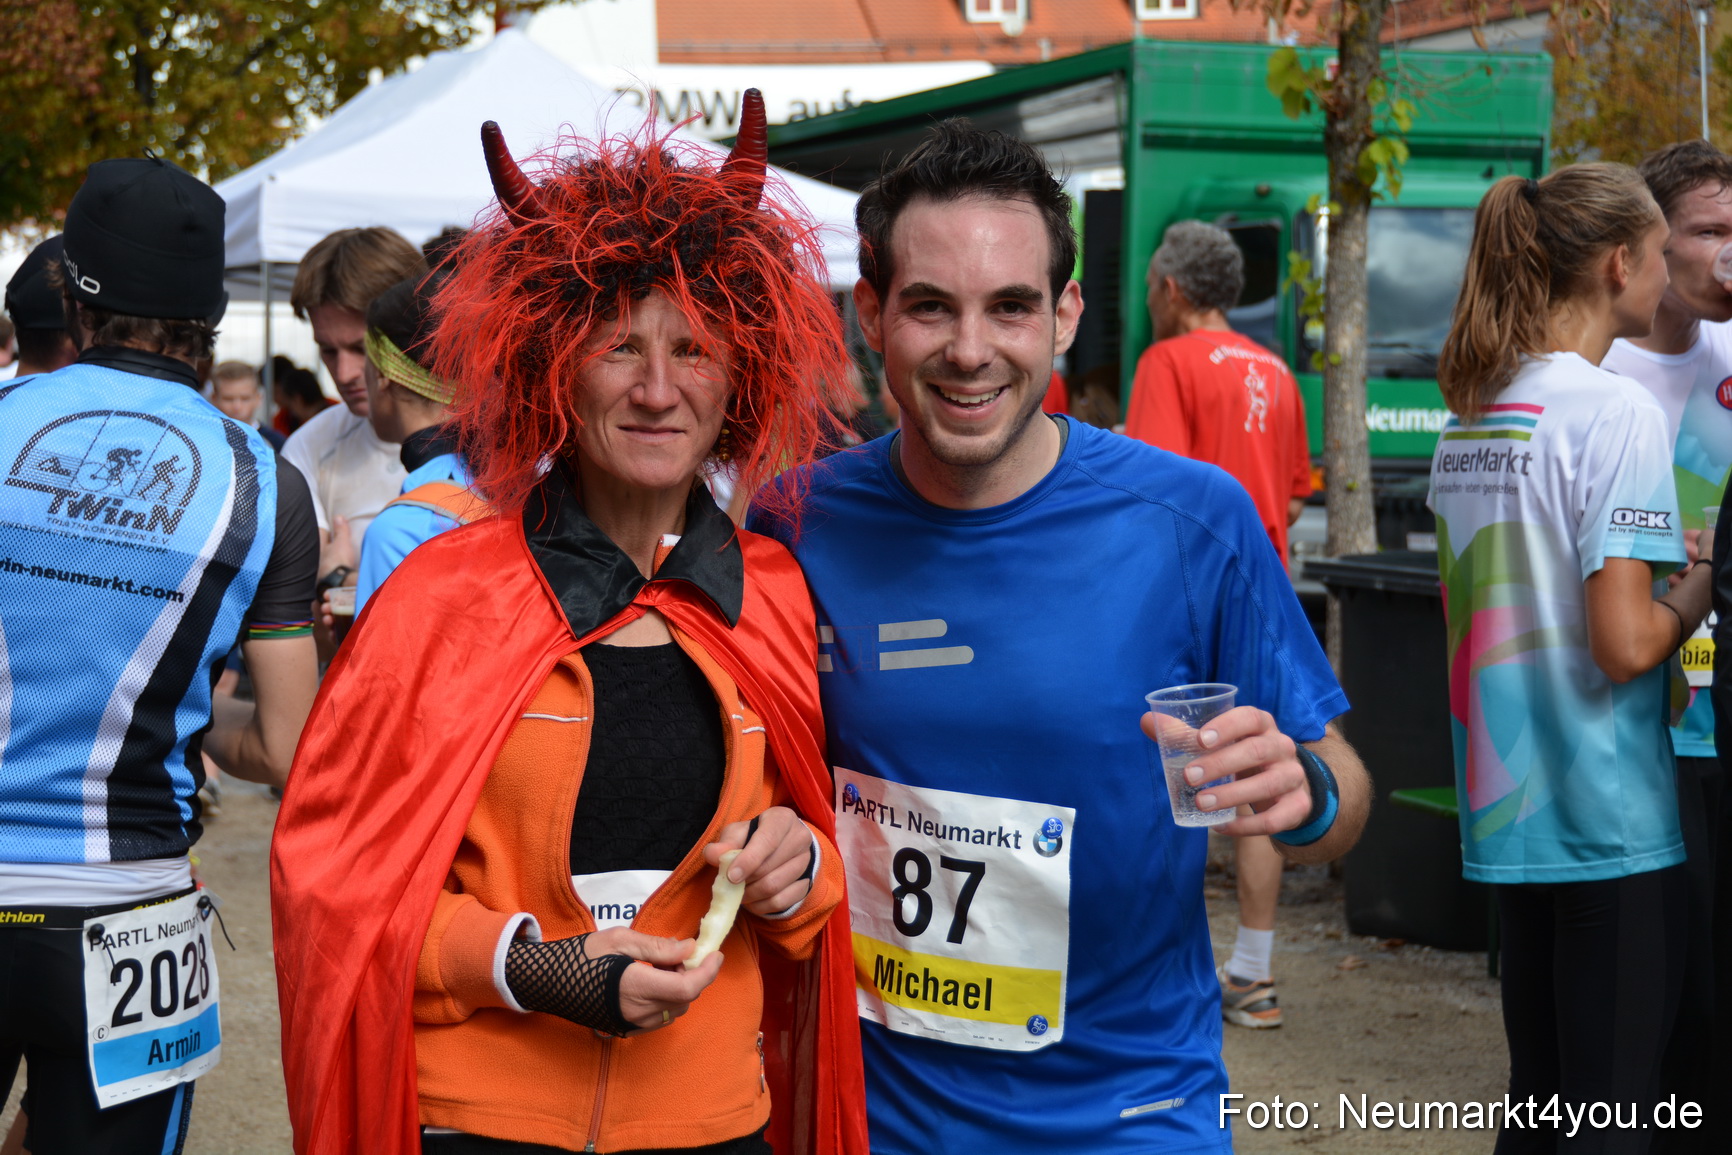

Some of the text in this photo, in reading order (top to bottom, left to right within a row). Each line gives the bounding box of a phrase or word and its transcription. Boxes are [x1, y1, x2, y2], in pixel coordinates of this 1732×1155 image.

[1618, 526, 1627, 534] by
[1643, 530, 1673, 538] concepts
[842, 793, 1022, 850] PARTL Neumarkt
[892, 847, 986, 945] 87
[90, 927, 153, 952] PARTL
[109, 933, 210, 1028] 2028
[873, 953, 993, 1012] Michael
[147, 1028, 201, 1066] Armin
